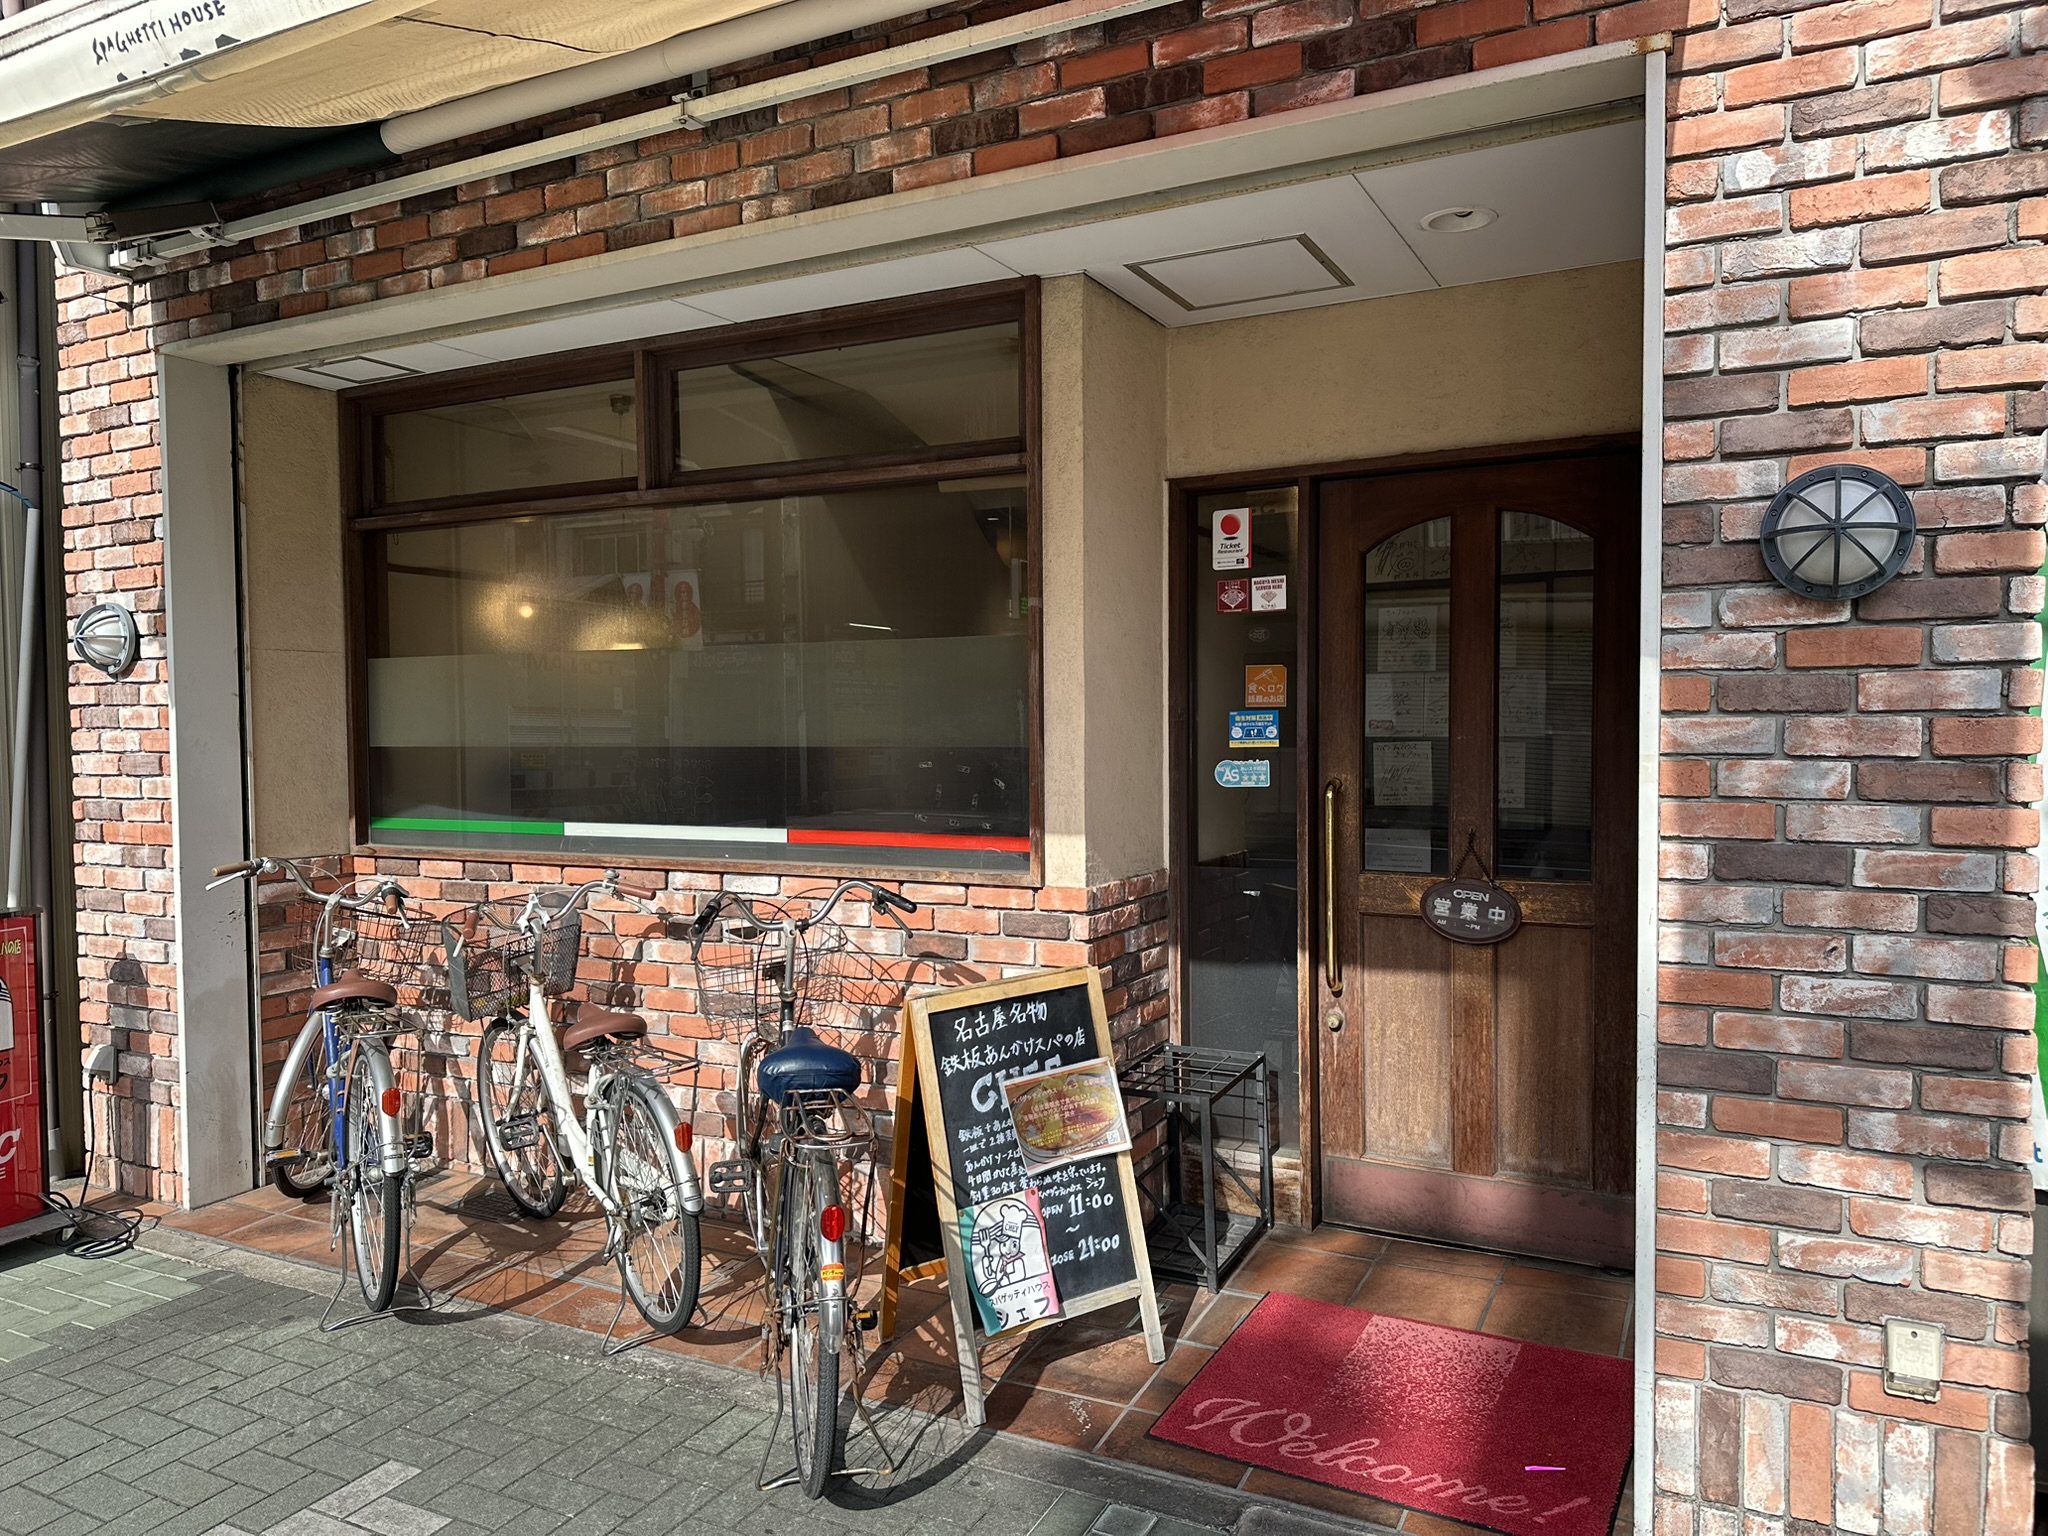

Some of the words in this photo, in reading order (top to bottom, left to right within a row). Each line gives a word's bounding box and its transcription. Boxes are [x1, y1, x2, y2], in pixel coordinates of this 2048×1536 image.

[92, 20, 166, 65] SPAGHETTI
[169, 0, 226, 34] HOUSE
[1220, 542, 1241, 550] Ticket
[1248, 682, 1284, 693] 食べログ
[1248, 695, 1284, 703] 話題のお店
[1222, 769, 1240, 781] AS
[1453, 889, 1490, 902] OPEN
[1434, 897, 1506, 921] 営業中
[953, 1000, 1048, 1043] 名古屋名物
[940, 1026, 1086, 1077] 鉄板あんかけスパの店
[1086, 1177, 1106, 1190] シェフ
[1042, 1204, 1063, 1219] OPEN
[1068, 1193, 1114, 1217] 11:00
[1078, 1234, 1120, 1262] 21:00
[989, 1282, 1050, 1306] スパゲッティハウス
[997, 1296, 1050, 1329] シェフ
[1185, 1397, 1590, 1524] Welcome!
